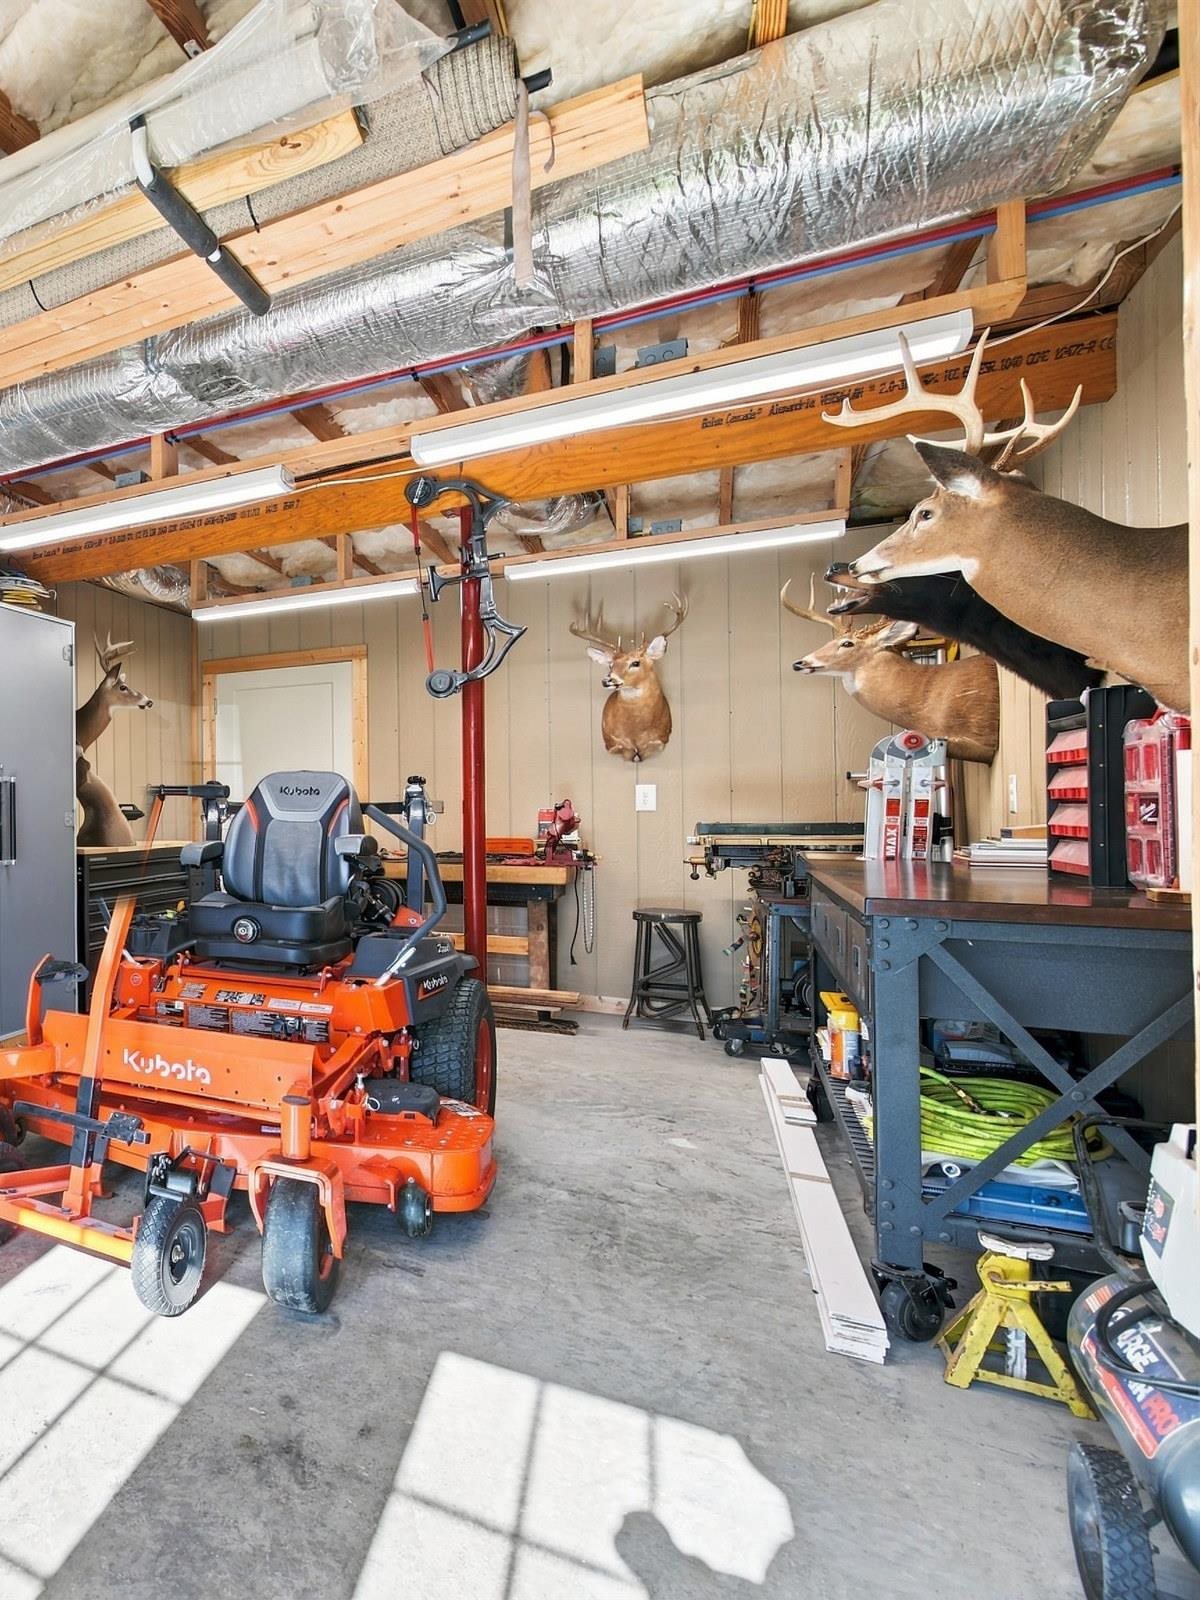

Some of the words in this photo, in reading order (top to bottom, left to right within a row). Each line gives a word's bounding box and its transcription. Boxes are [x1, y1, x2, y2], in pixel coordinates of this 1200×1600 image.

[279, 785, 320, 796] Kubota
[886, 826, 897, 857] MAX
[422, 974, 449, 990] Kubota
[123, 1048, 212, 1086] Kubota
